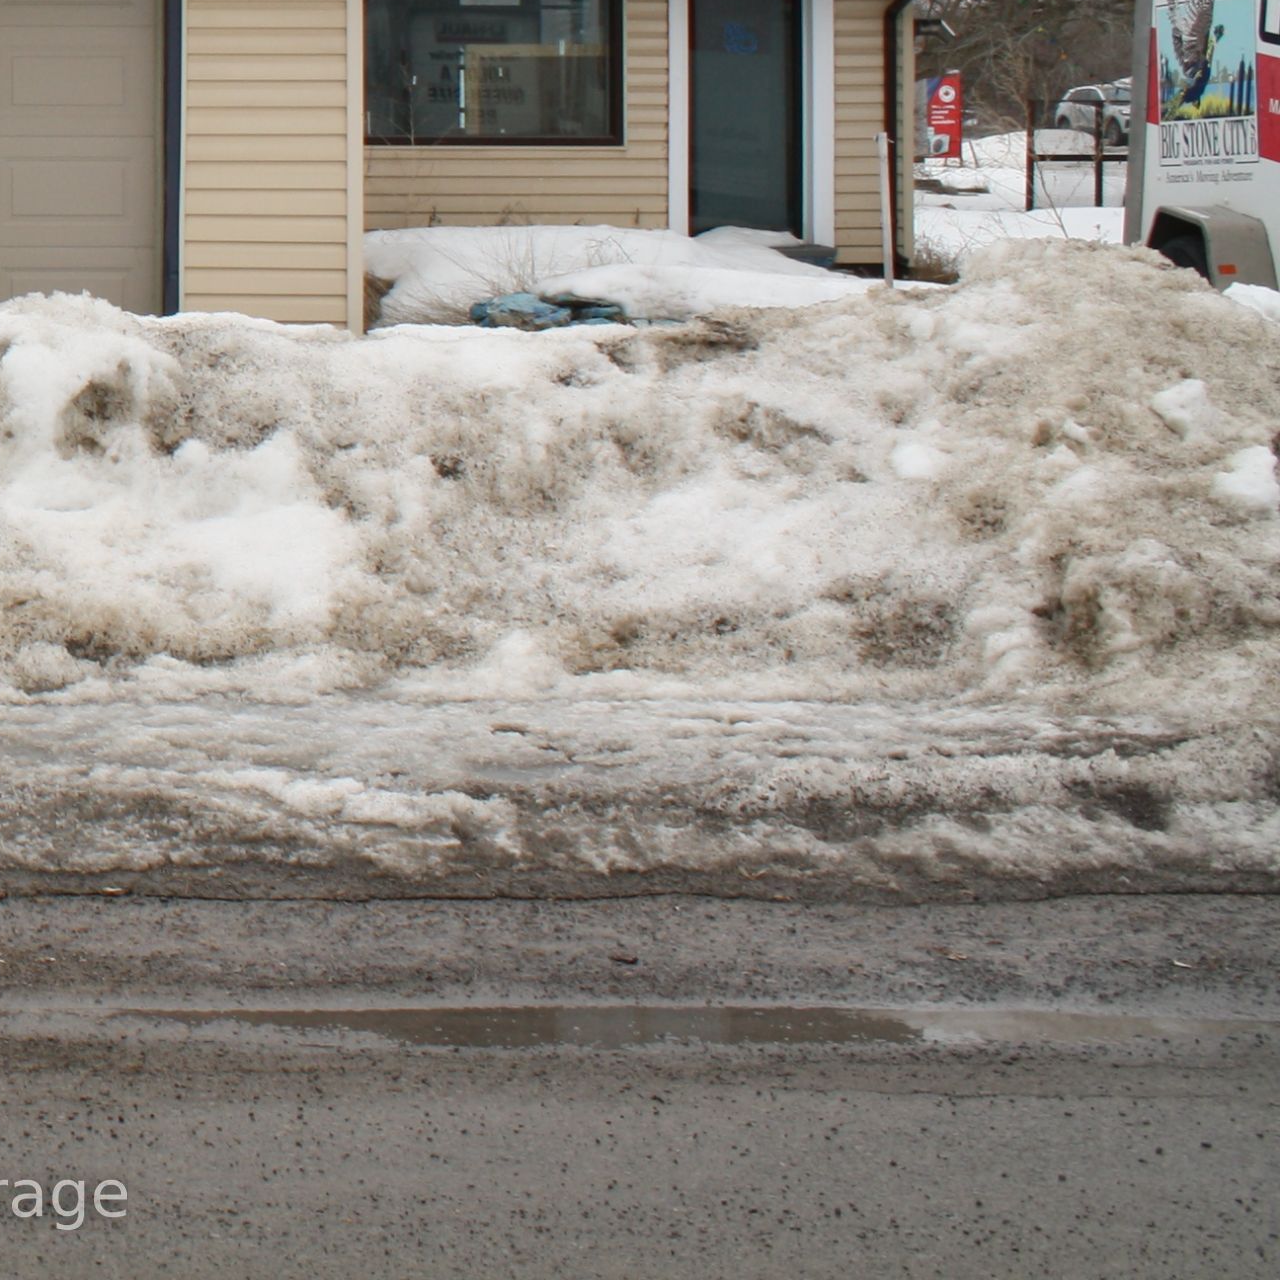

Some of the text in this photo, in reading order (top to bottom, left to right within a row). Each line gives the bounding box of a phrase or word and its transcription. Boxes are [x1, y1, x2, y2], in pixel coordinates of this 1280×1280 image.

[1160, 124, 1180, 159] BIG
[1182, 121, 1219, 157] STONE
[1223, 119, 1249, 156] CITY
